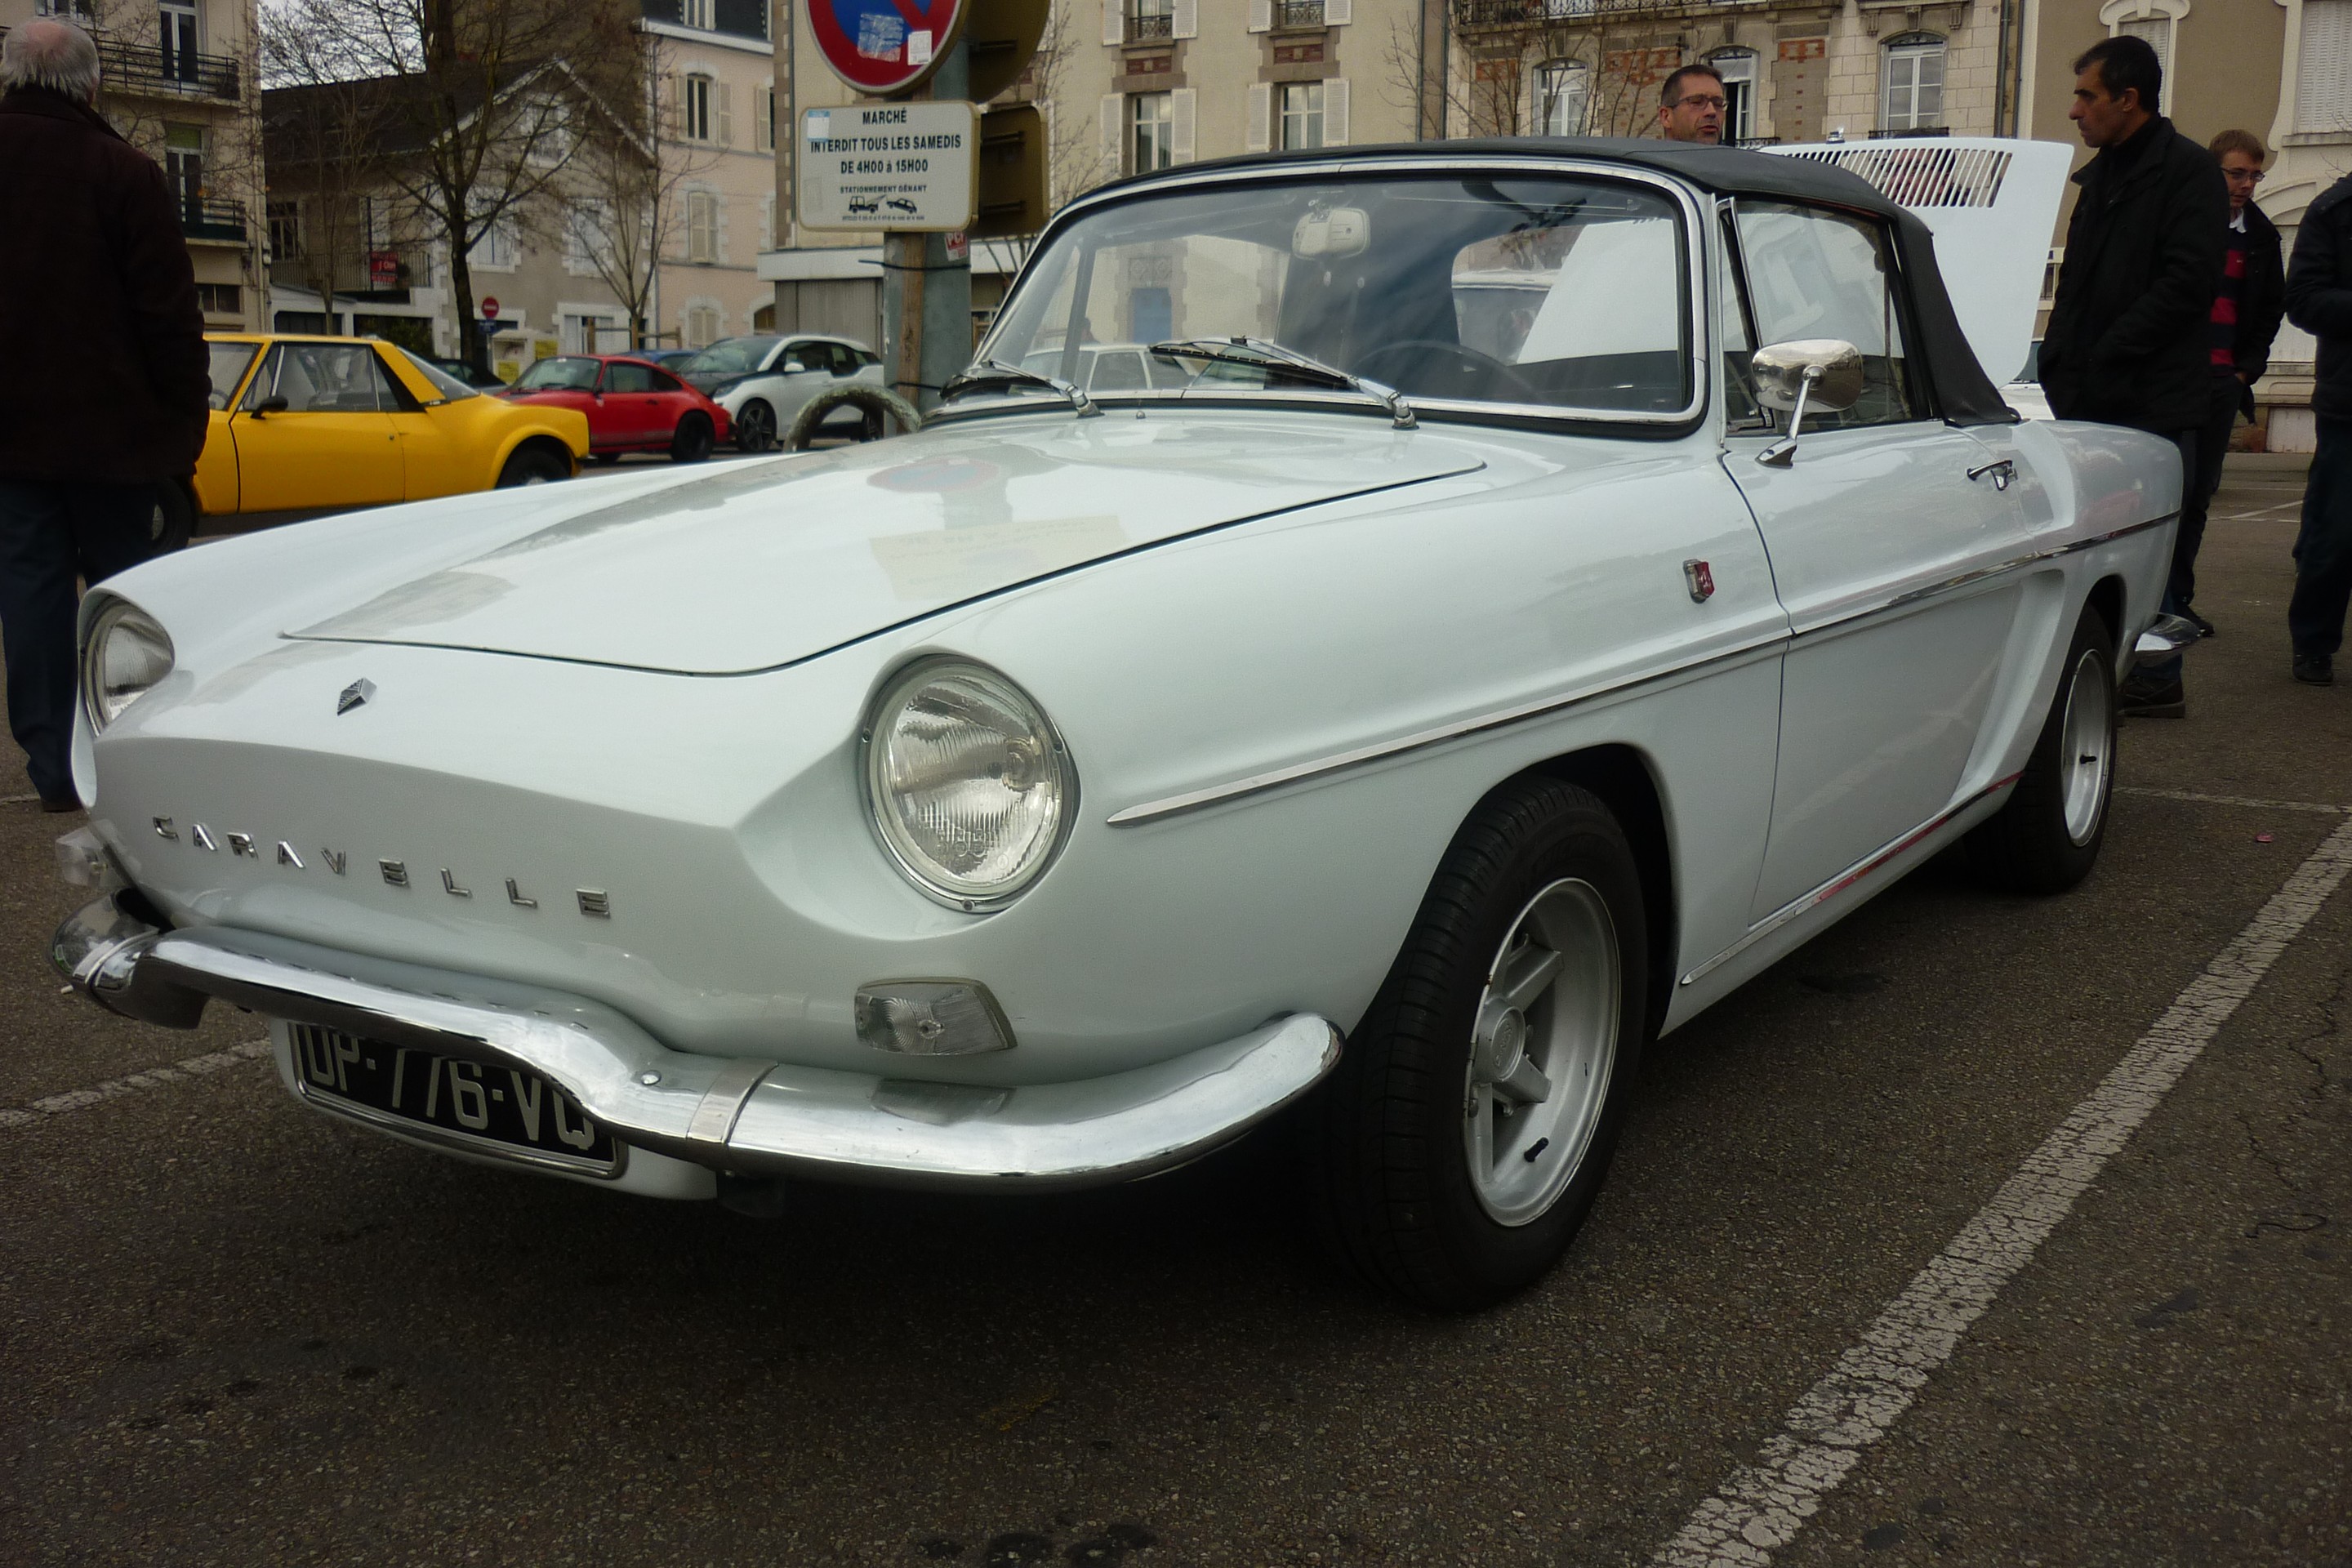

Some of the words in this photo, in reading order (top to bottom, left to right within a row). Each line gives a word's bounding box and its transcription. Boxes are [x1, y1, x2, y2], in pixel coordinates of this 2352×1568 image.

[862, 107, 907, 125] MARCHÉ
[811, 138, 858, 154] INTERDIT
[861, 137, 889, 151] TOUS
[891, 136, 911, 151] LES
[913, 135, 961, 150] SAMEDIS
[840, 161, 854, 175] DE
[857, 160, 884, 174] 4H00
[896, 158, 929, 173] 15H00
[153, 816, 611, 919] CARAVELLE
